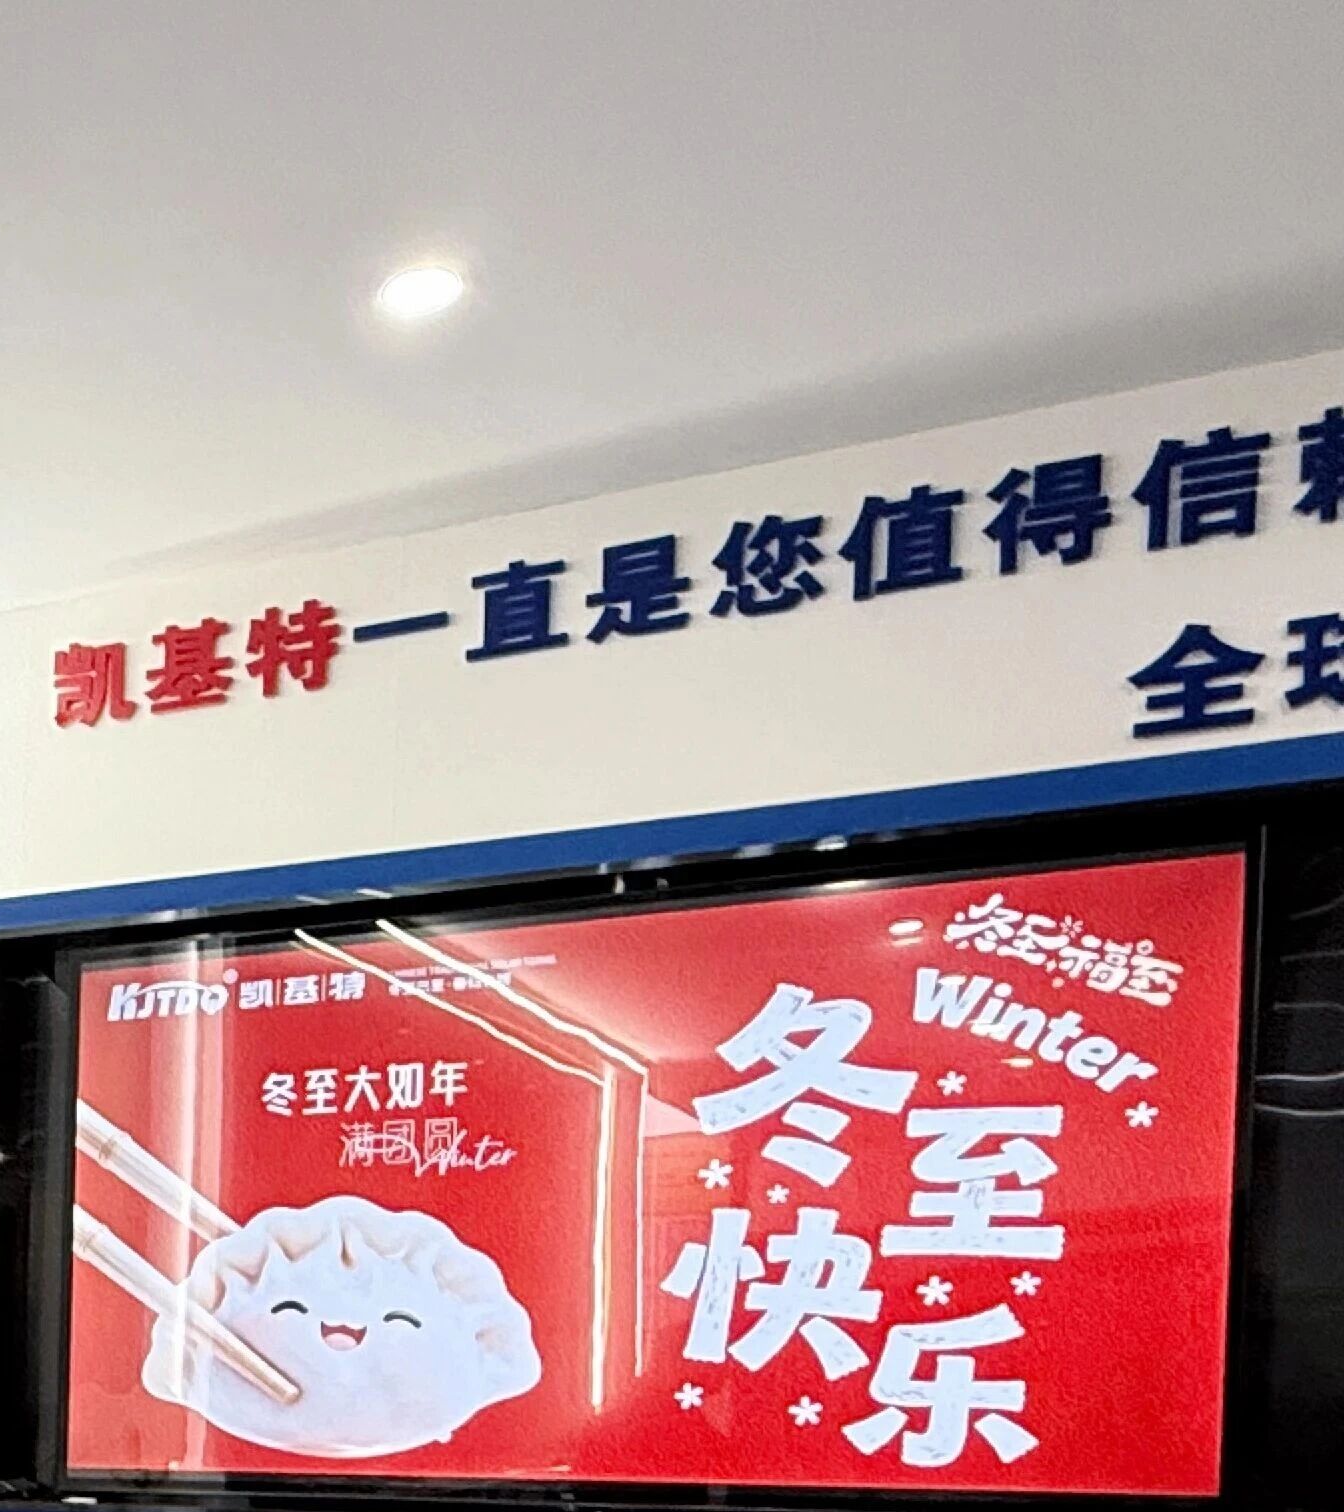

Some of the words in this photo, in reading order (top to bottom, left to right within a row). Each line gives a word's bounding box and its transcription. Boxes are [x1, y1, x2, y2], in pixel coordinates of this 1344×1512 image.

[913, 967, 1158, 1093] Winter
[261, 1060, 468, 1118] 冬至大如年
